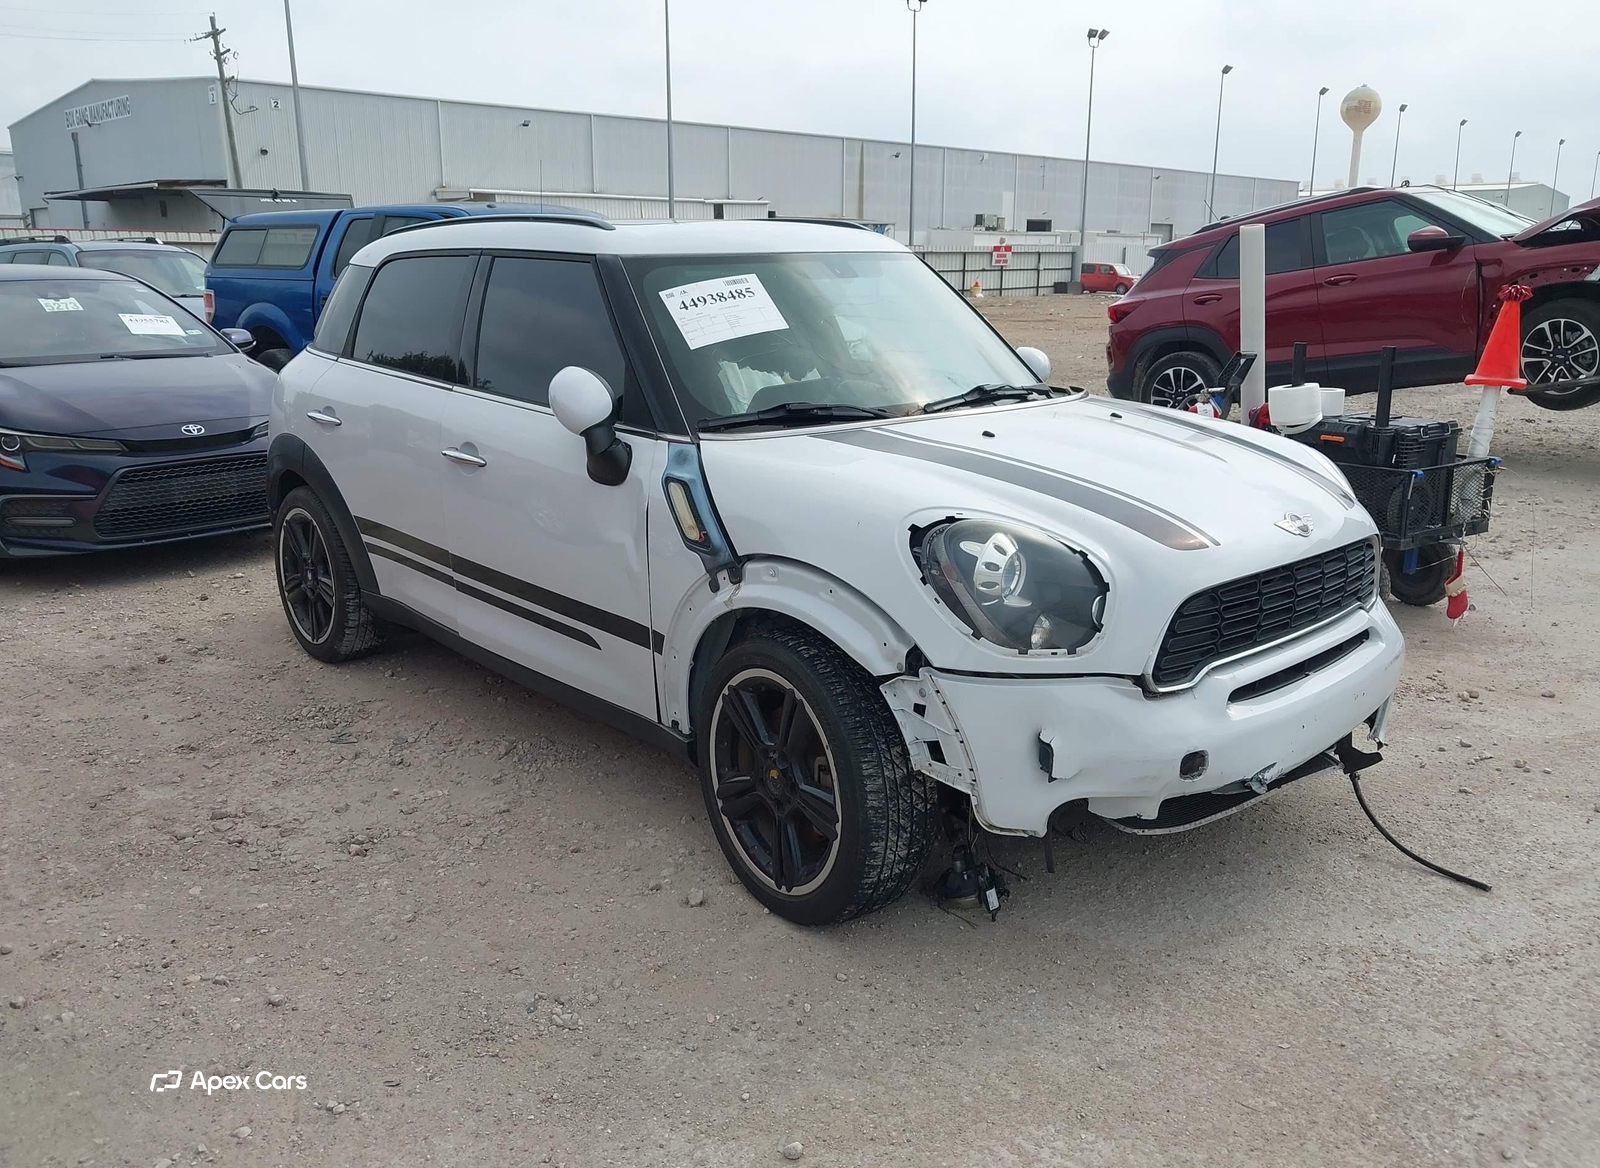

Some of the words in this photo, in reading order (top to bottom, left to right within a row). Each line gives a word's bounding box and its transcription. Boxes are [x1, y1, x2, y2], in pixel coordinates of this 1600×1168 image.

[65, 110, 76, 128] BOX
[88, 96, 130, 122] MANUFACTURING
[273, 100, 279, 108] 2
[44, 302, 80, 310] 5273
[679, 287, 756, 311] 44938485
